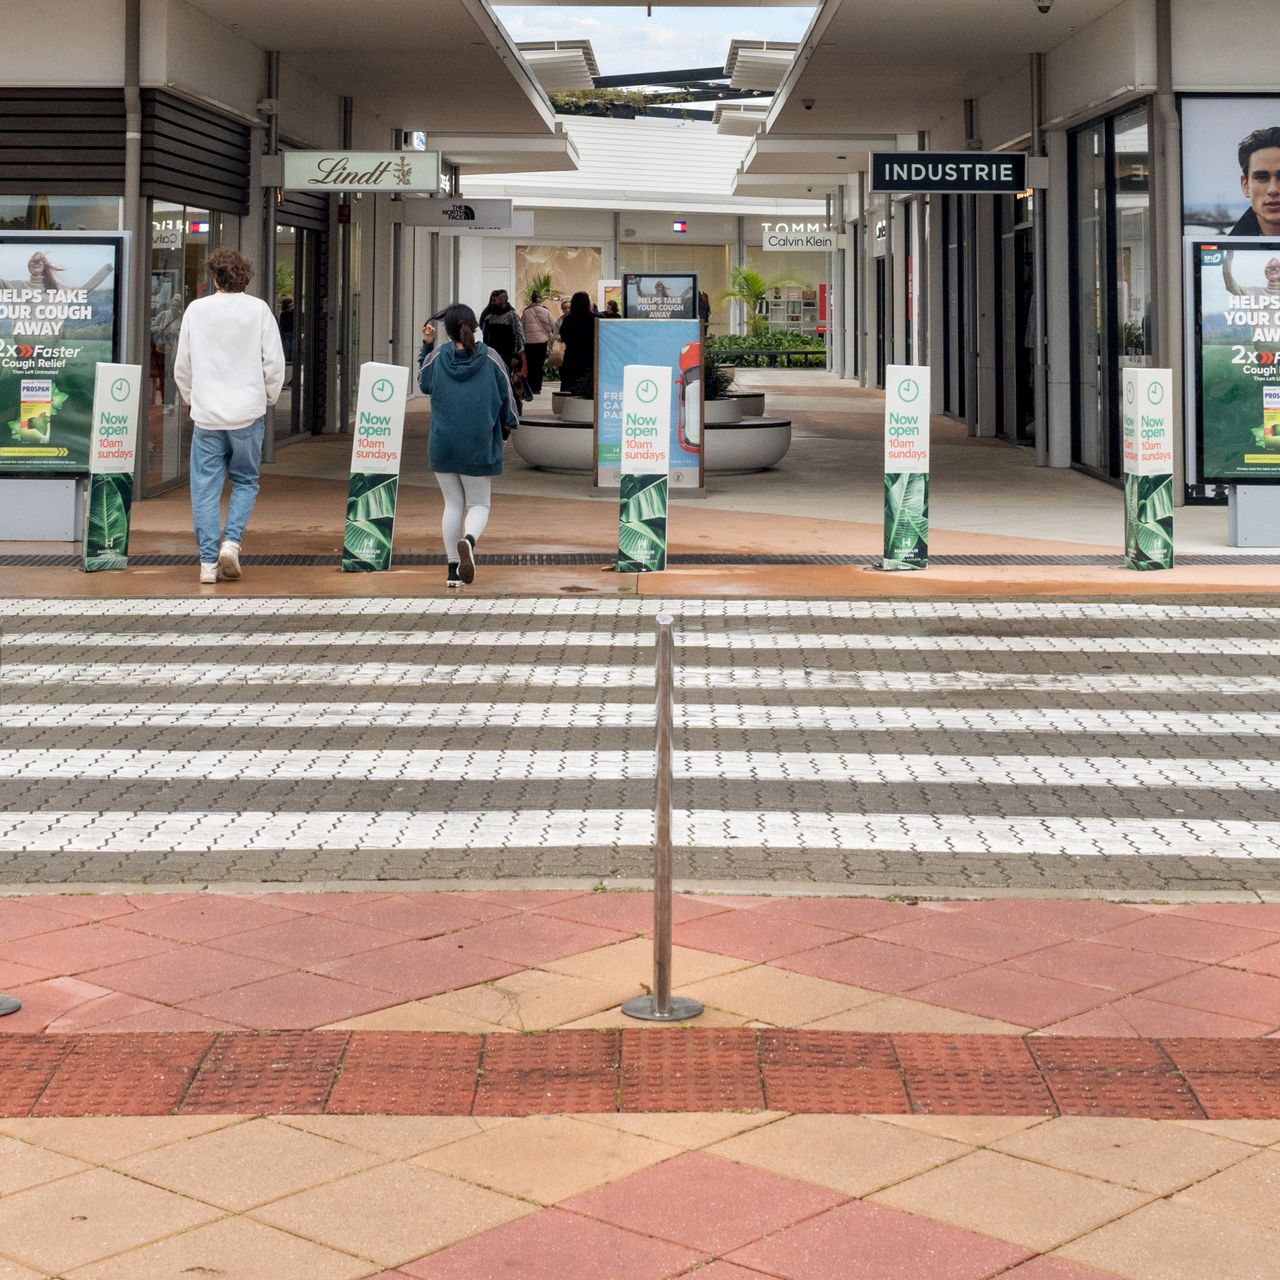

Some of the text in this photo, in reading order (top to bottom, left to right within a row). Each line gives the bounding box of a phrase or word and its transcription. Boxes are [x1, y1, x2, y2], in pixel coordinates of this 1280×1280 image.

[308, 157, 393, 185] Lindt
[885, 163, 1013, 181] INDUSTRIE
[768, 235, 832, 246] Calvin Klein
[46, 289, 87, 303] TAKE
[659, 304, 684, 312] COUGH
[1228, 296, 1280, 309] HELPS
[35, 305, 92, 320] COUGH
[649, 311, 672, 319] AWAY
[1224, 312, 1269, 325] YOUR
[13, 321, 63, 336] AWAY
[1232, 345, 1259, 364] 2x
[2, 359, 66, 369] Cough Relief
[1243, 365, 1277, 376] Cough
[604, 392, 624, 400] FRE
[603, 401, 624, 410] CA
[100, 412, 128, 425] Now
[359, 412, 392, 425] Now
[603, 410, 624, 419] PAS
[626, 413, 657, 426] Now
[889, 412, 918, 425] Now
[1141, 415, 1164, 427] Now
[99, 425, 128, 437] open
[358, 425, 391, 438] open
[625, 427, 657, 439] open
[889, 426, 919, 438] open
[1141, 427, 1165, 440] open
[99, 439, 123, 448] 10am
[357, 439, 385, 448] 10am
[625, 440, 652, 449] 10am
[888, 439, 914, 448] 10am
[1141, 441, 1161, 450] 10am
[97, 448, 133, 460] sundays
[356, 449, 398, 461] sundays
[625, 450, 665, 461] sundays
[888, 449, 927, 460] sundays
[1140, 451, 1171, 462] sundays
